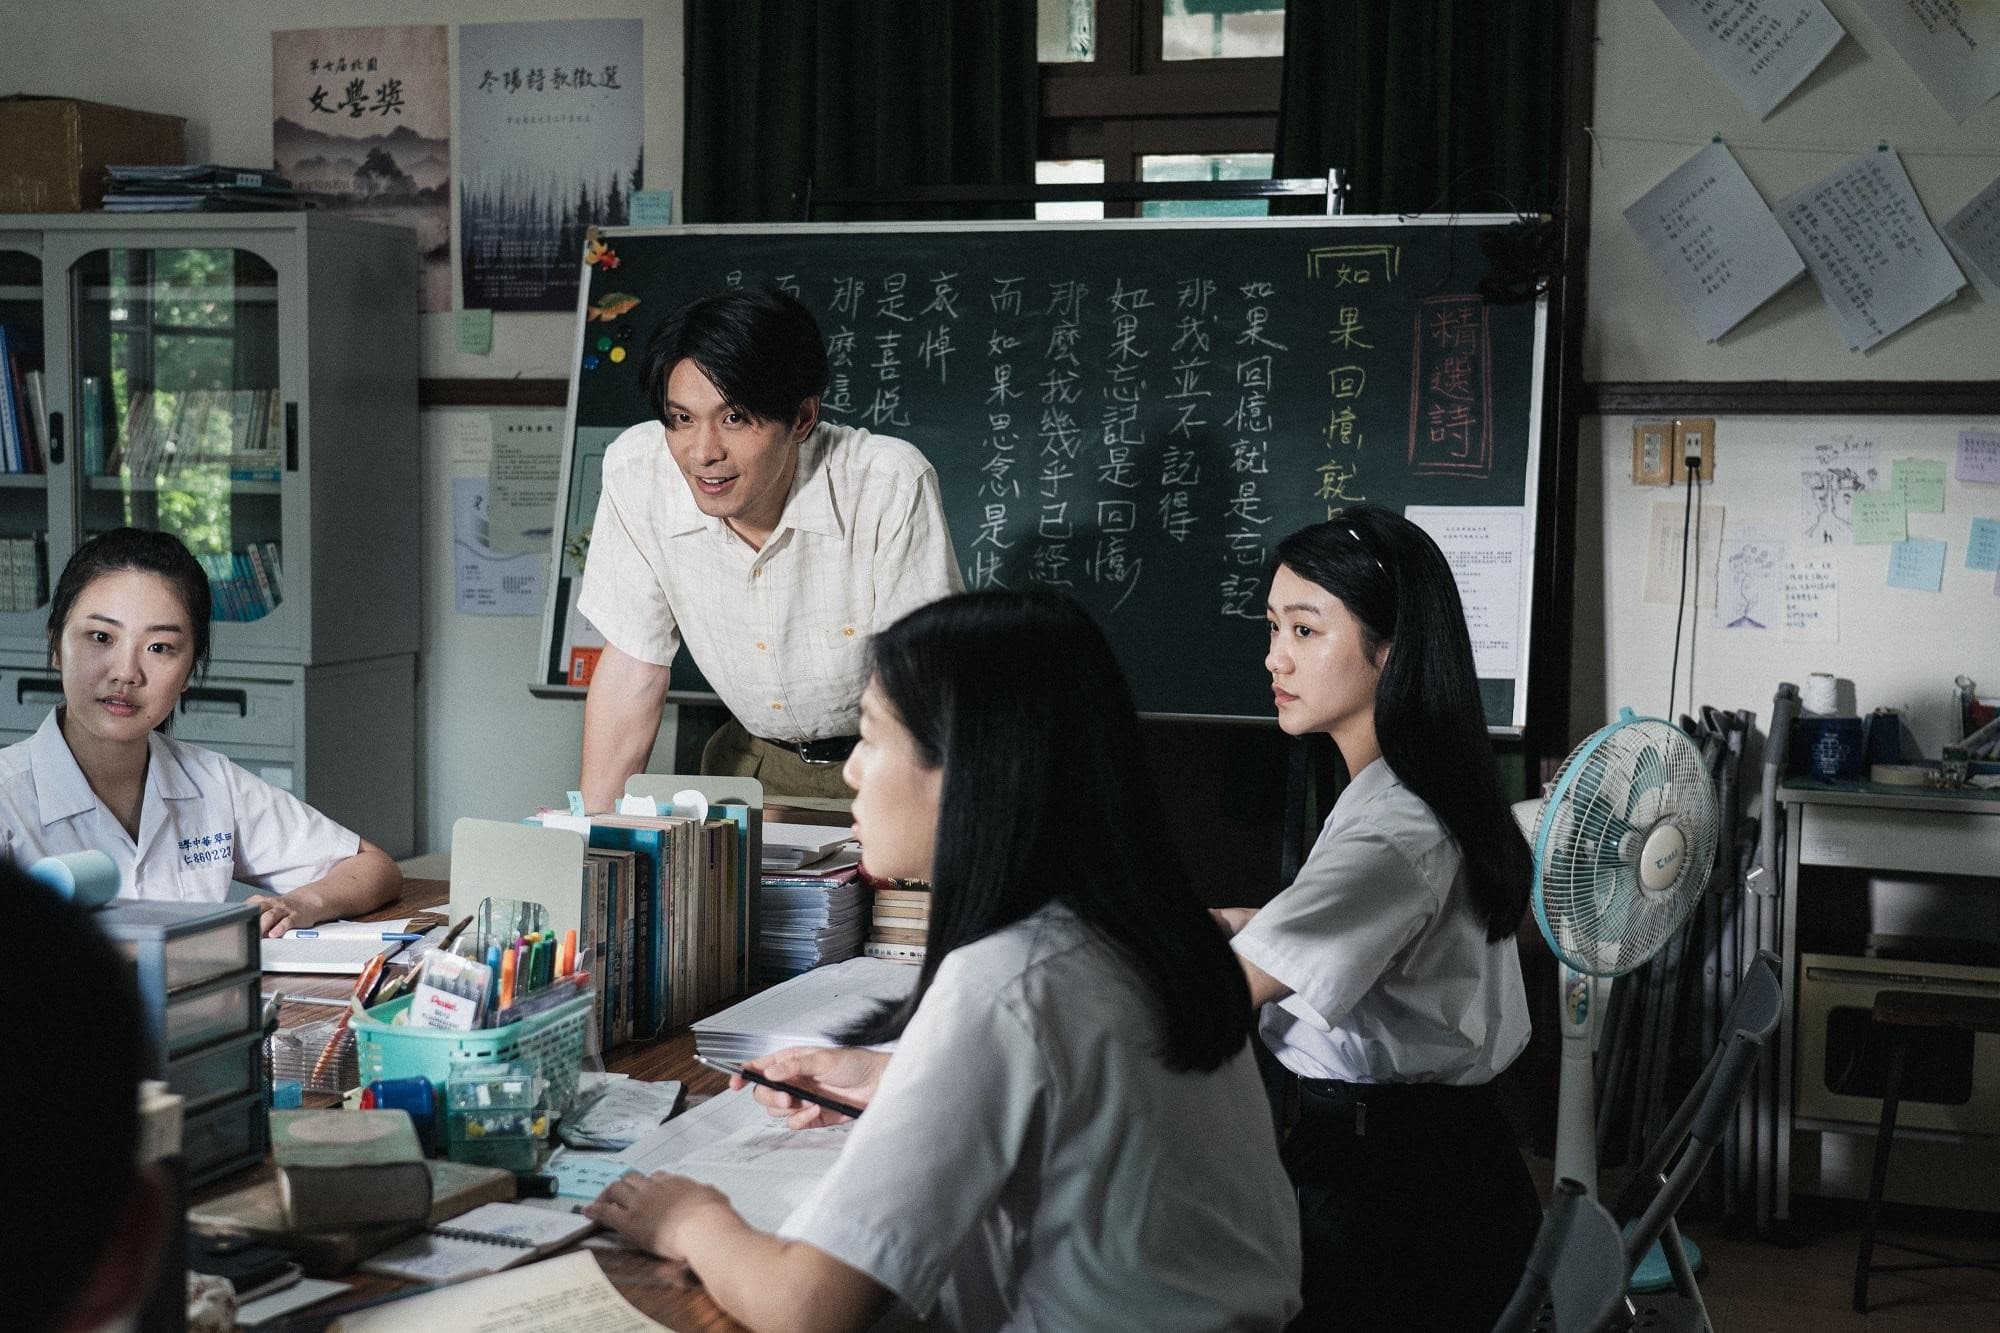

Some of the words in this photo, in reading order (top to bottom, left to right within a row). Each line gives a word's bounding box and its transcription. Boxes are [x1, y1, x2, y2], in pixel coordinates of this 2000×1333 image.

[309, 78, 405, 118] 文學獎
[861, 271, 914, 428] 是喜悅
[917, 271, 960, 385] 哀悼
[1426, 306, 1478, 460] 精選詩
